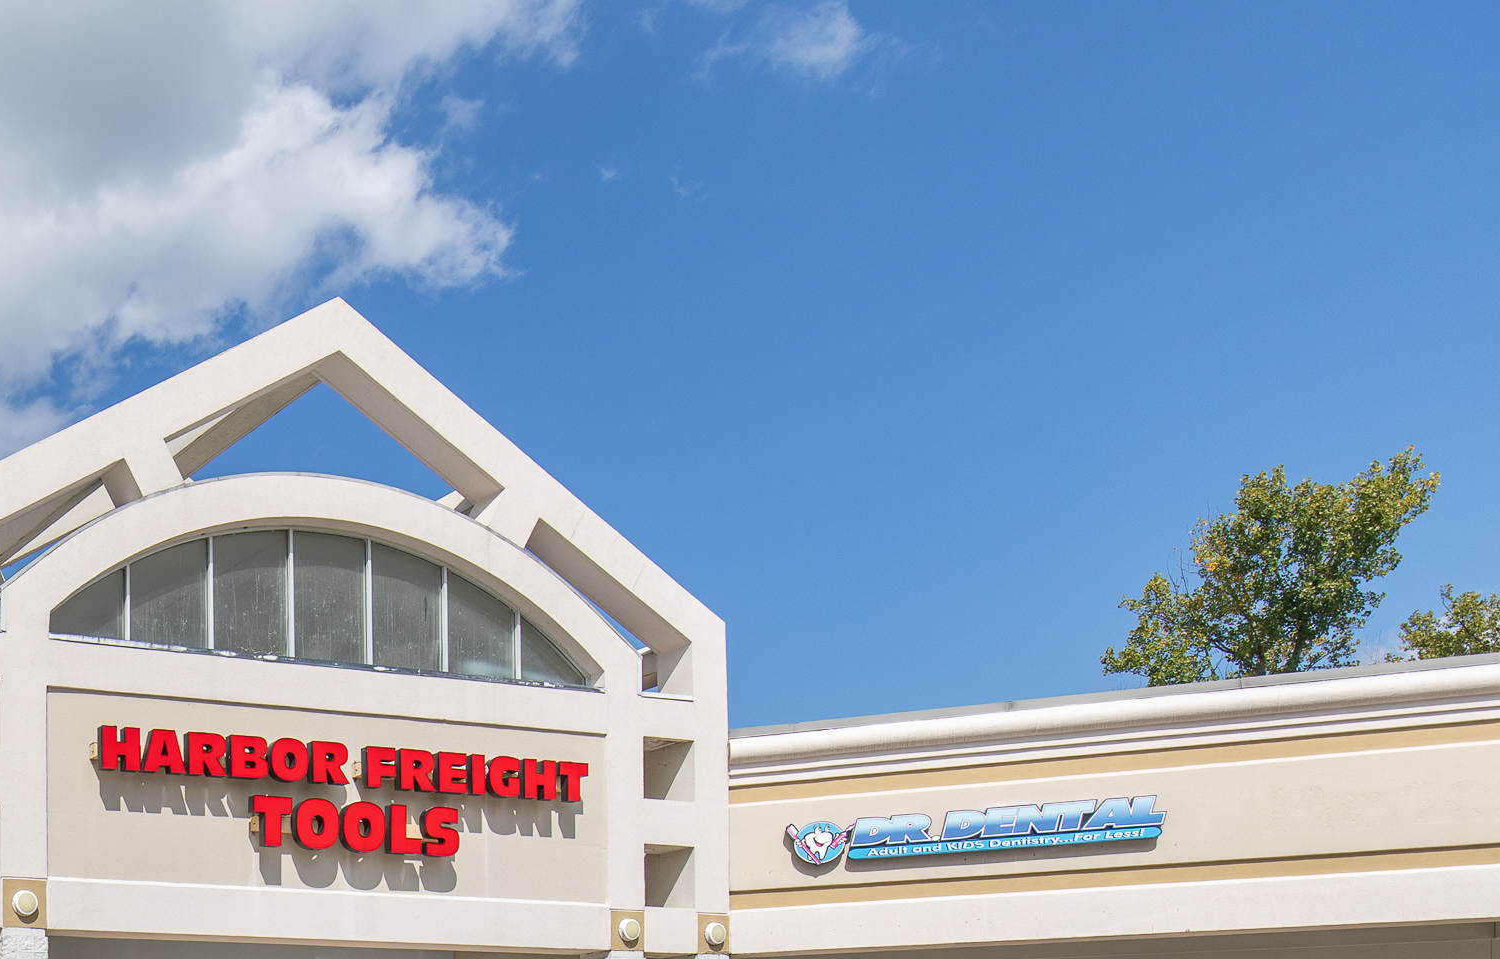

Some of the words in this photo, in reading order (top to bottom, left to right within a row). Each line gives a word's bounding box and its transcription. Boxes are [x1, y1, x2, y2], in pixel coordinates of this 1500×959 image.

[98, 725, 349, 786] HARBOR
[361, 745, 589, 802] FREIGHT
[249, 794, 460, 857] TOOLS
[851, 813, 940, 847] DR.
[941, 795, 1167, 841] DENTAL
[866, 845, 909, 857] Adult
[911, 842, 941, 854] and
[946, 840, 984, 851] KIDS
[1104, 828, 1145, 840] Less!
